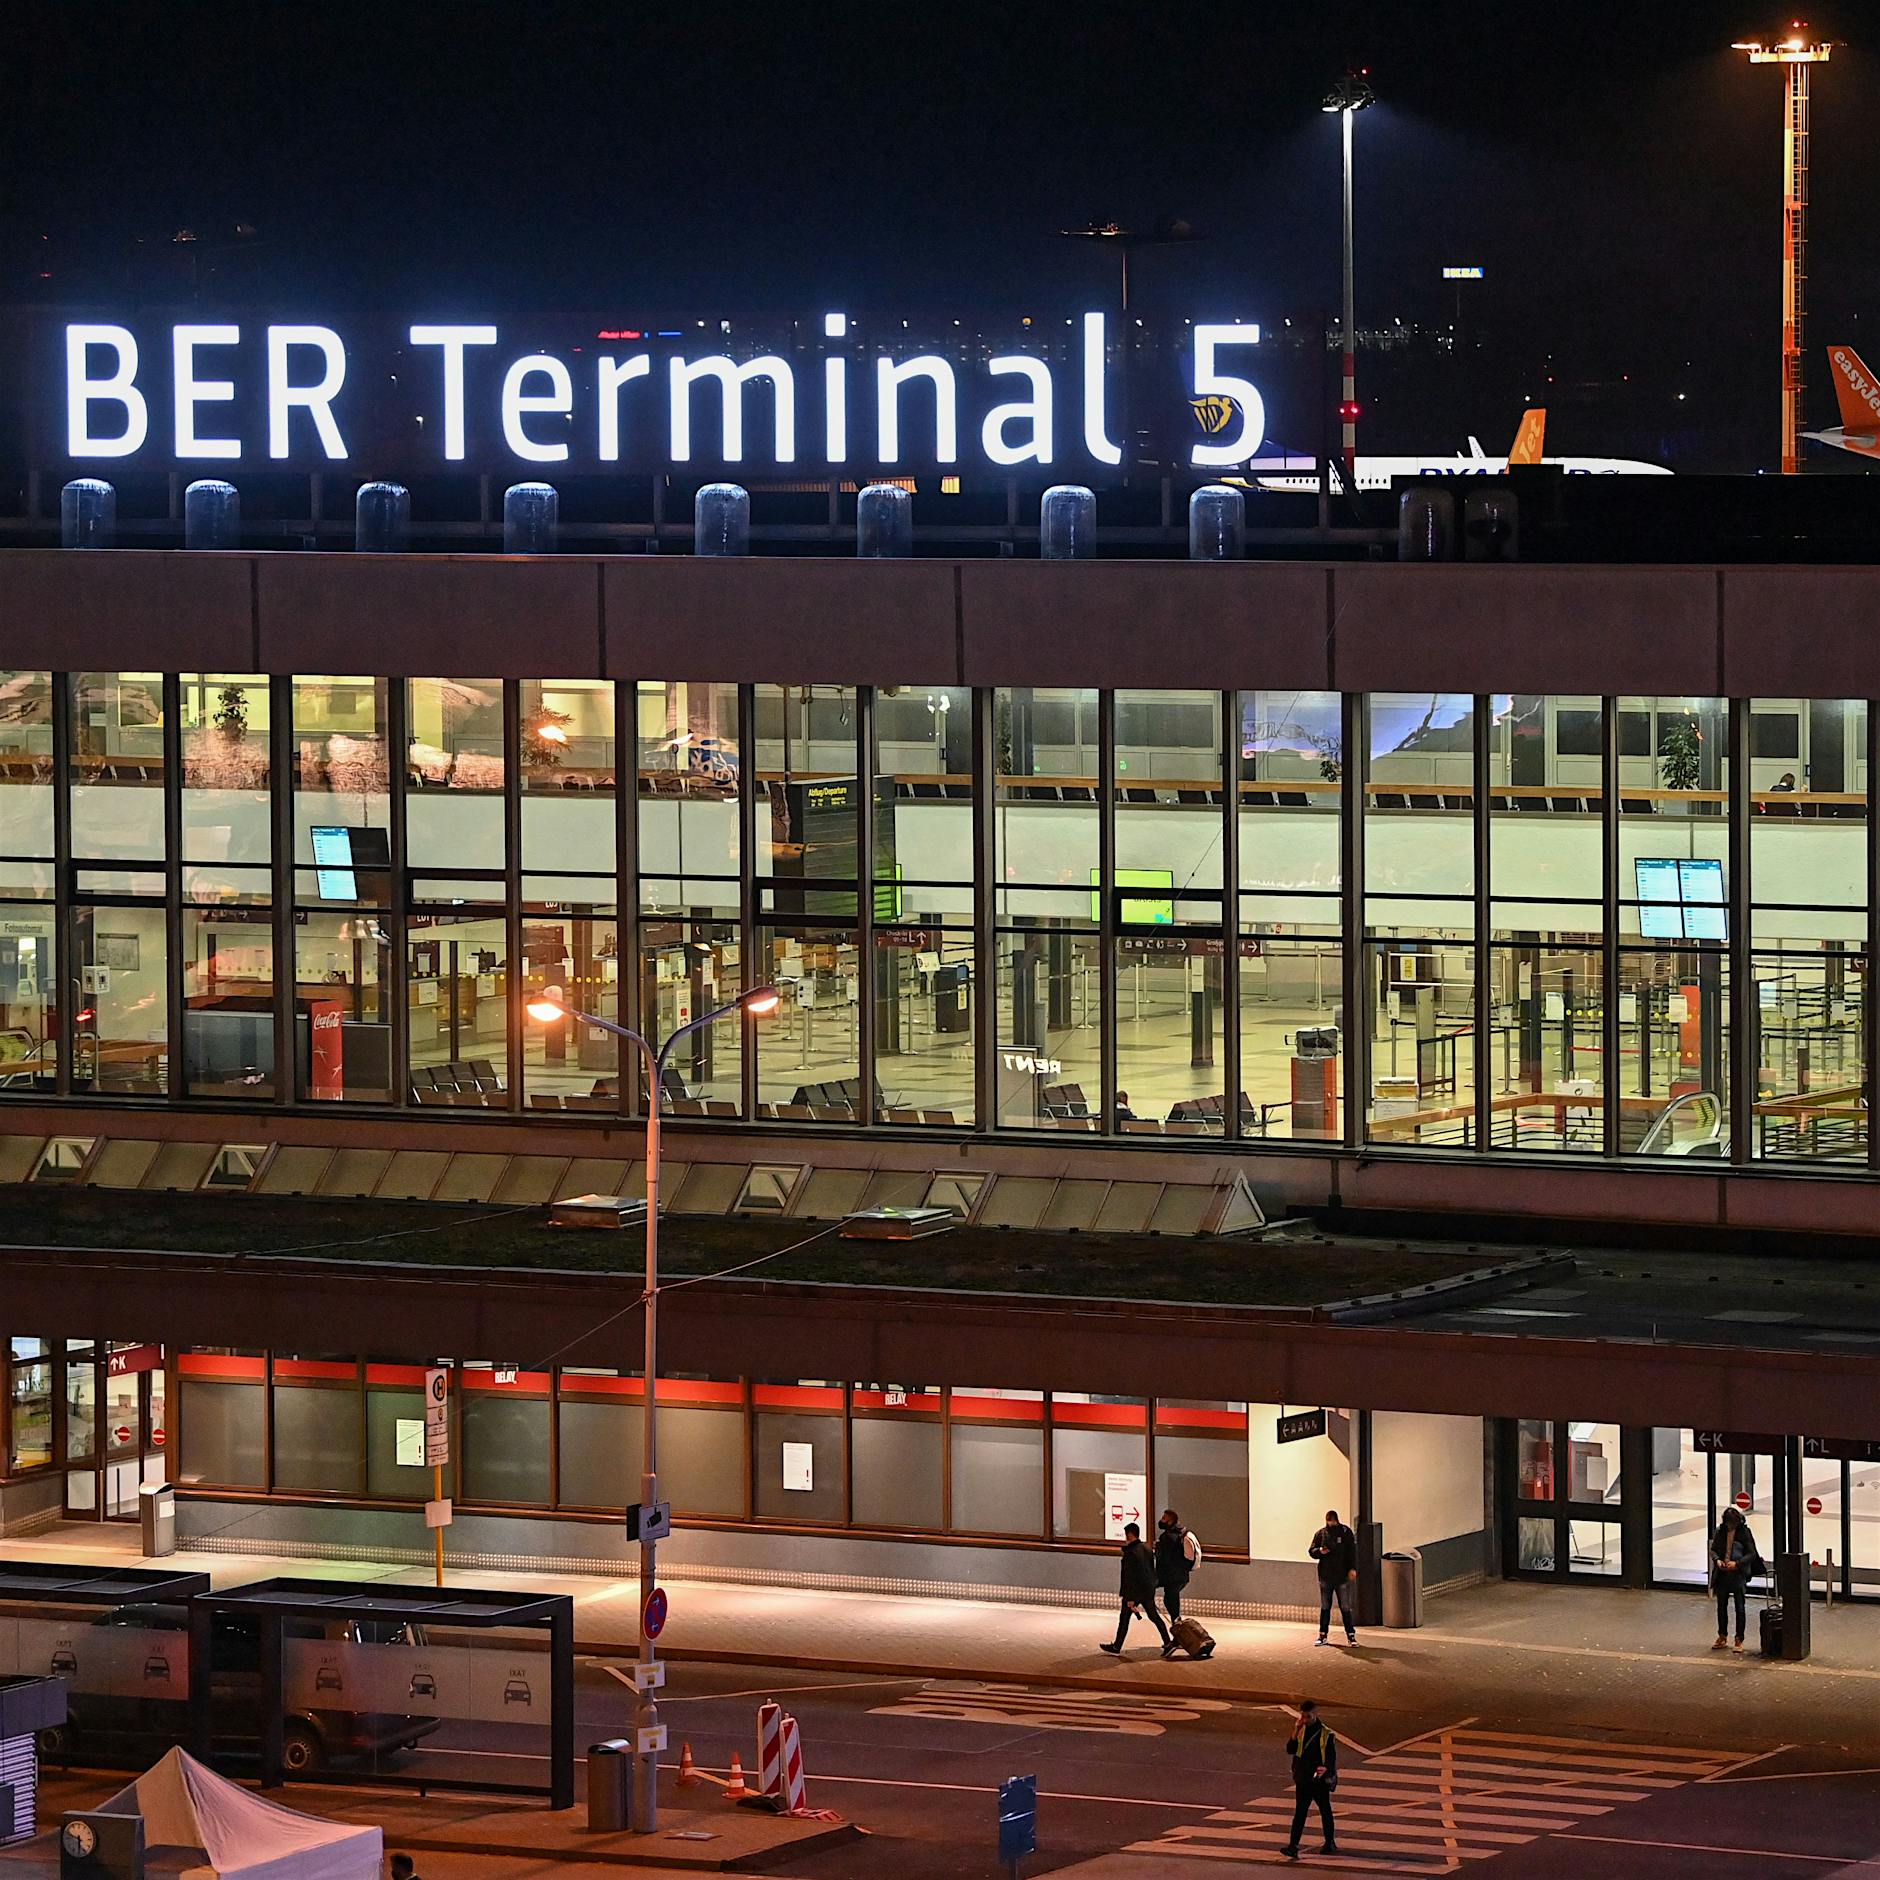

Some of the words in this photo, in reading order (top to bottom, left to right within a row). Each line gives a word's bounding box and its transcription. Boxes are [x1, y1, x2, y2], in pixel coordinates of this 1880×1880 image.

[1443, 267, 1482, 278] IKEA
[67, 325, 347, 458] BER
[410, 313, 1121, 464] Terminal
[1191, 323, 1266, 467] 5
[1834, 351, 1880, 418] easyJe
[118, 1355, 127, 1370] K
[494, 1371, 516, 1384] RELAY
[885, 1393, 906, 1405] RELAY
[1713, 1433, 1723, 1448] K
[1820, 1439, 1830, 1454] L
